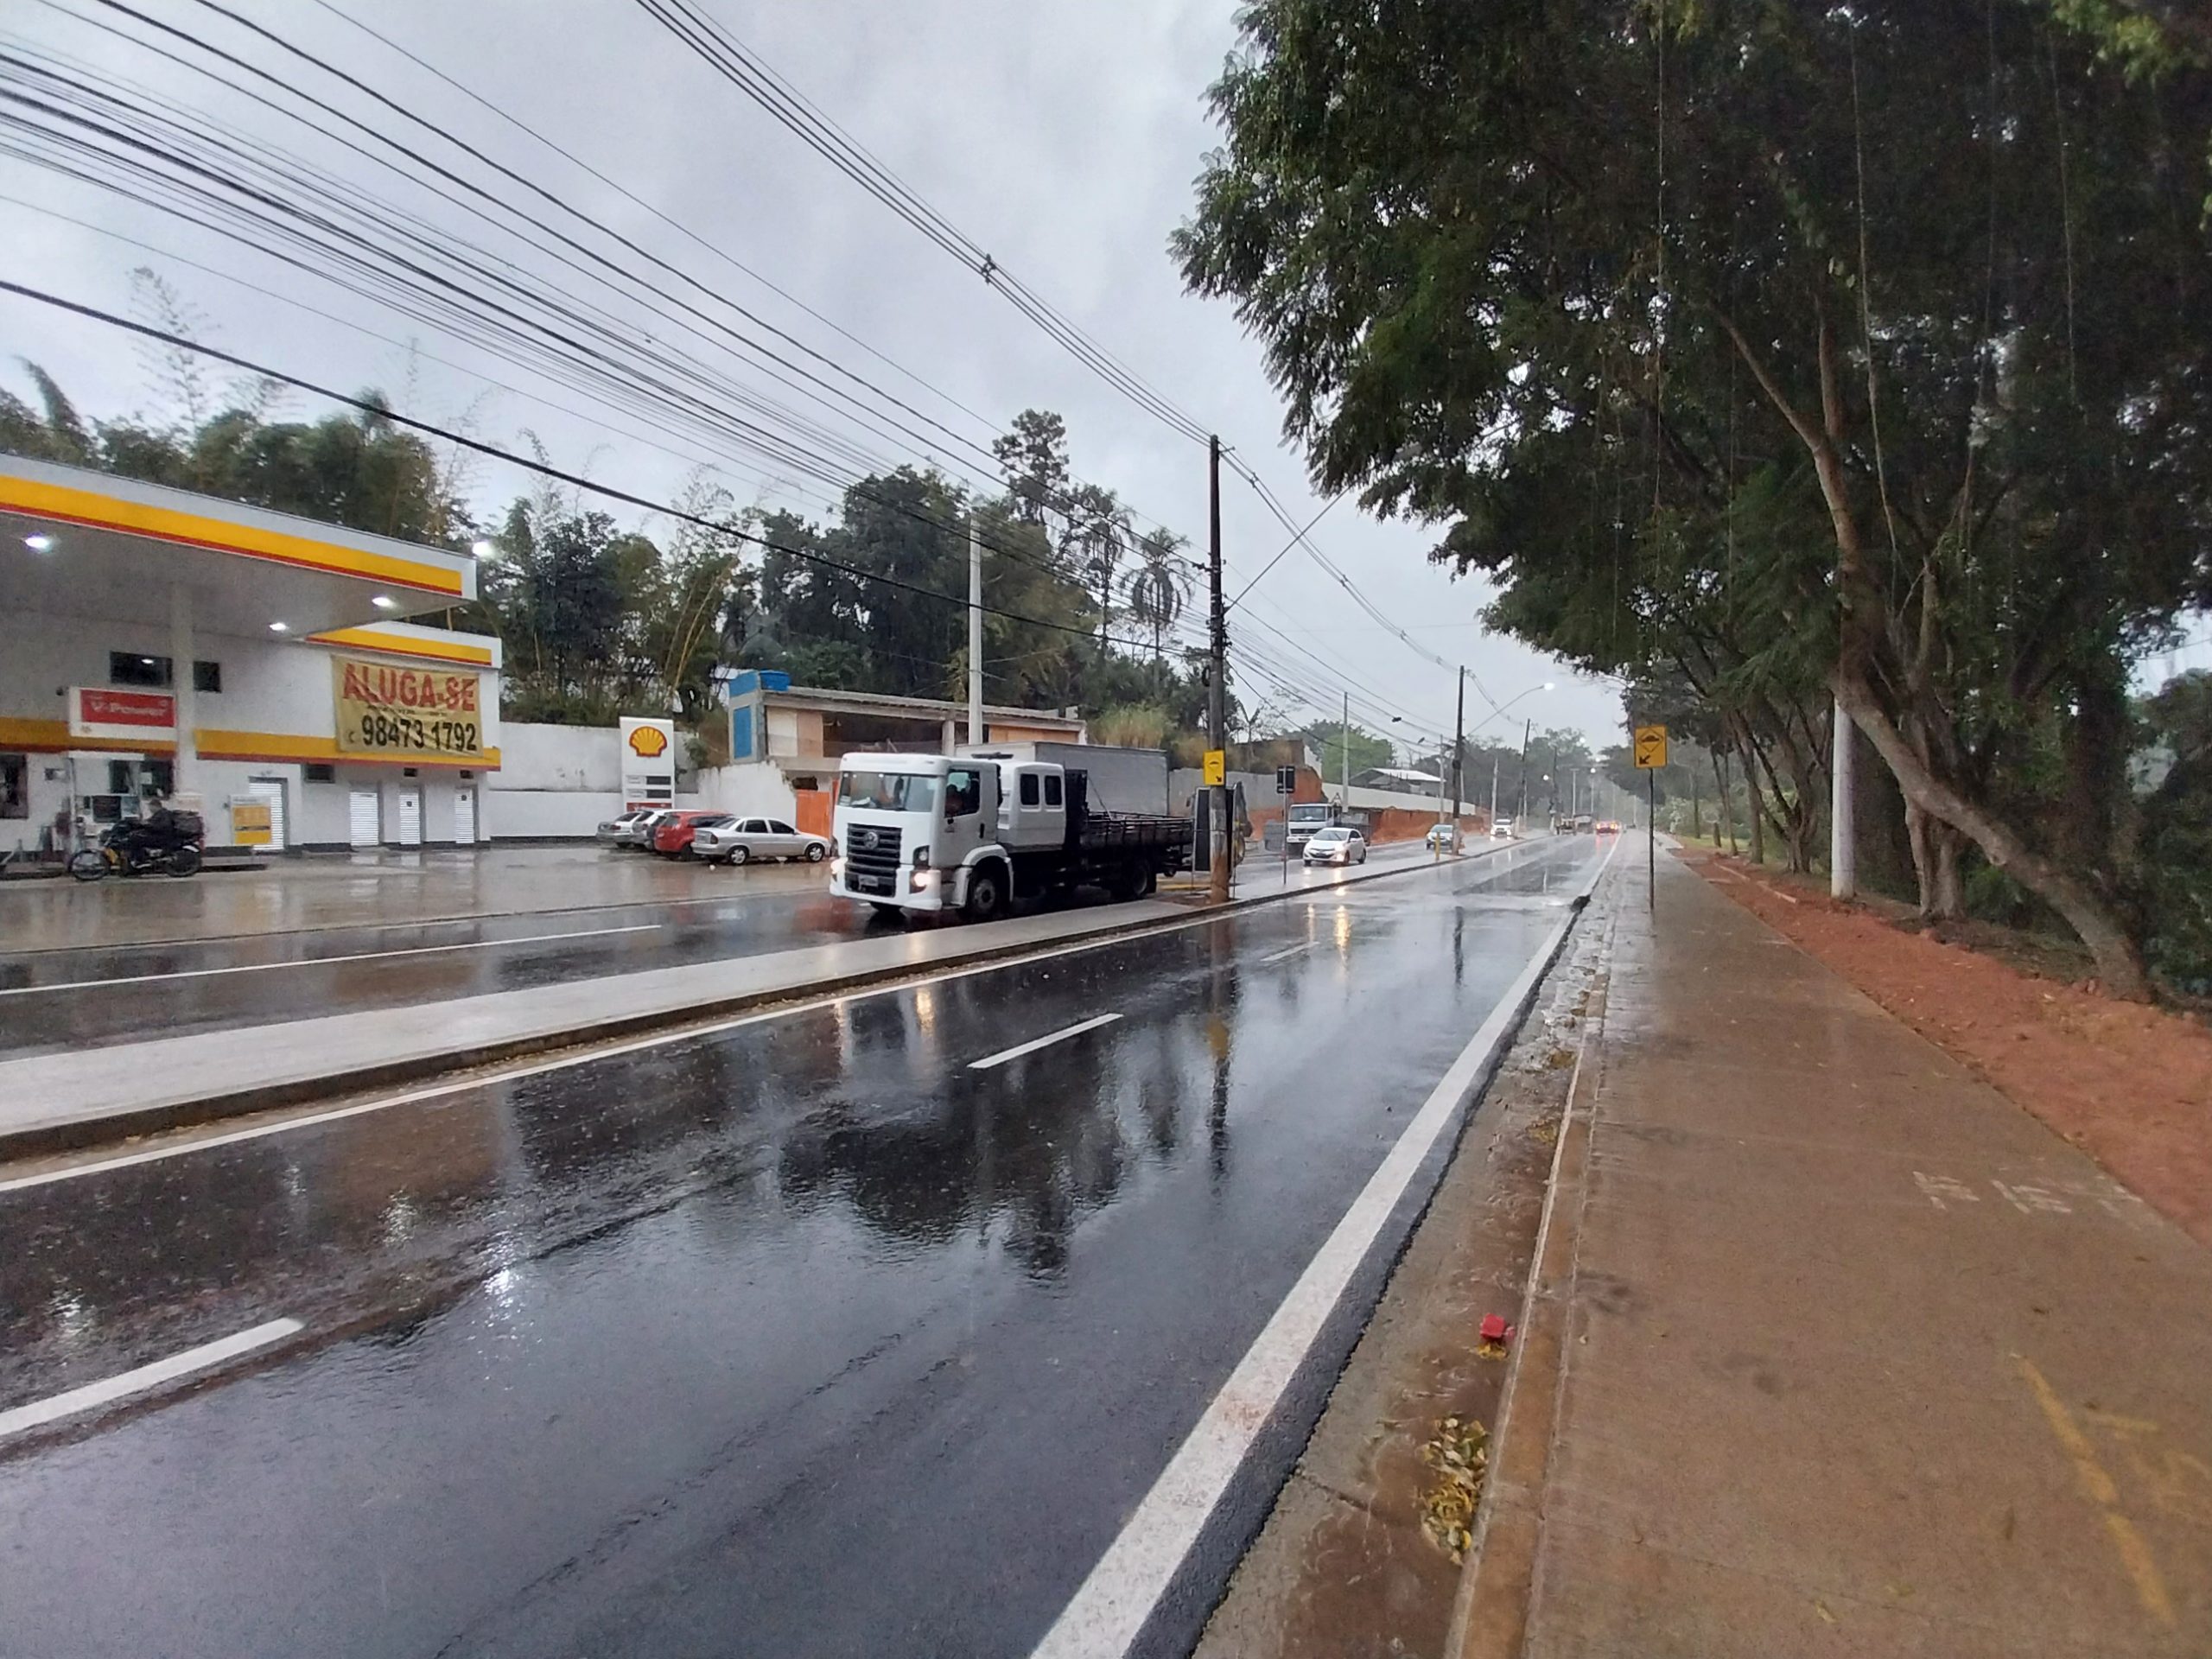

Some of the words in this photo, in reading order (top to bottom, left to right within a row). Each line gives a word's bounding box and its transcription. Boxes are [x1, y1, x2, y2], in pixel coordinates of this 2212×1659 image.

[343, 663, 476, 712] ALUGA-SE
[362, 715, 424, 749] 98473
[430, 721, 477, 752] 1792
